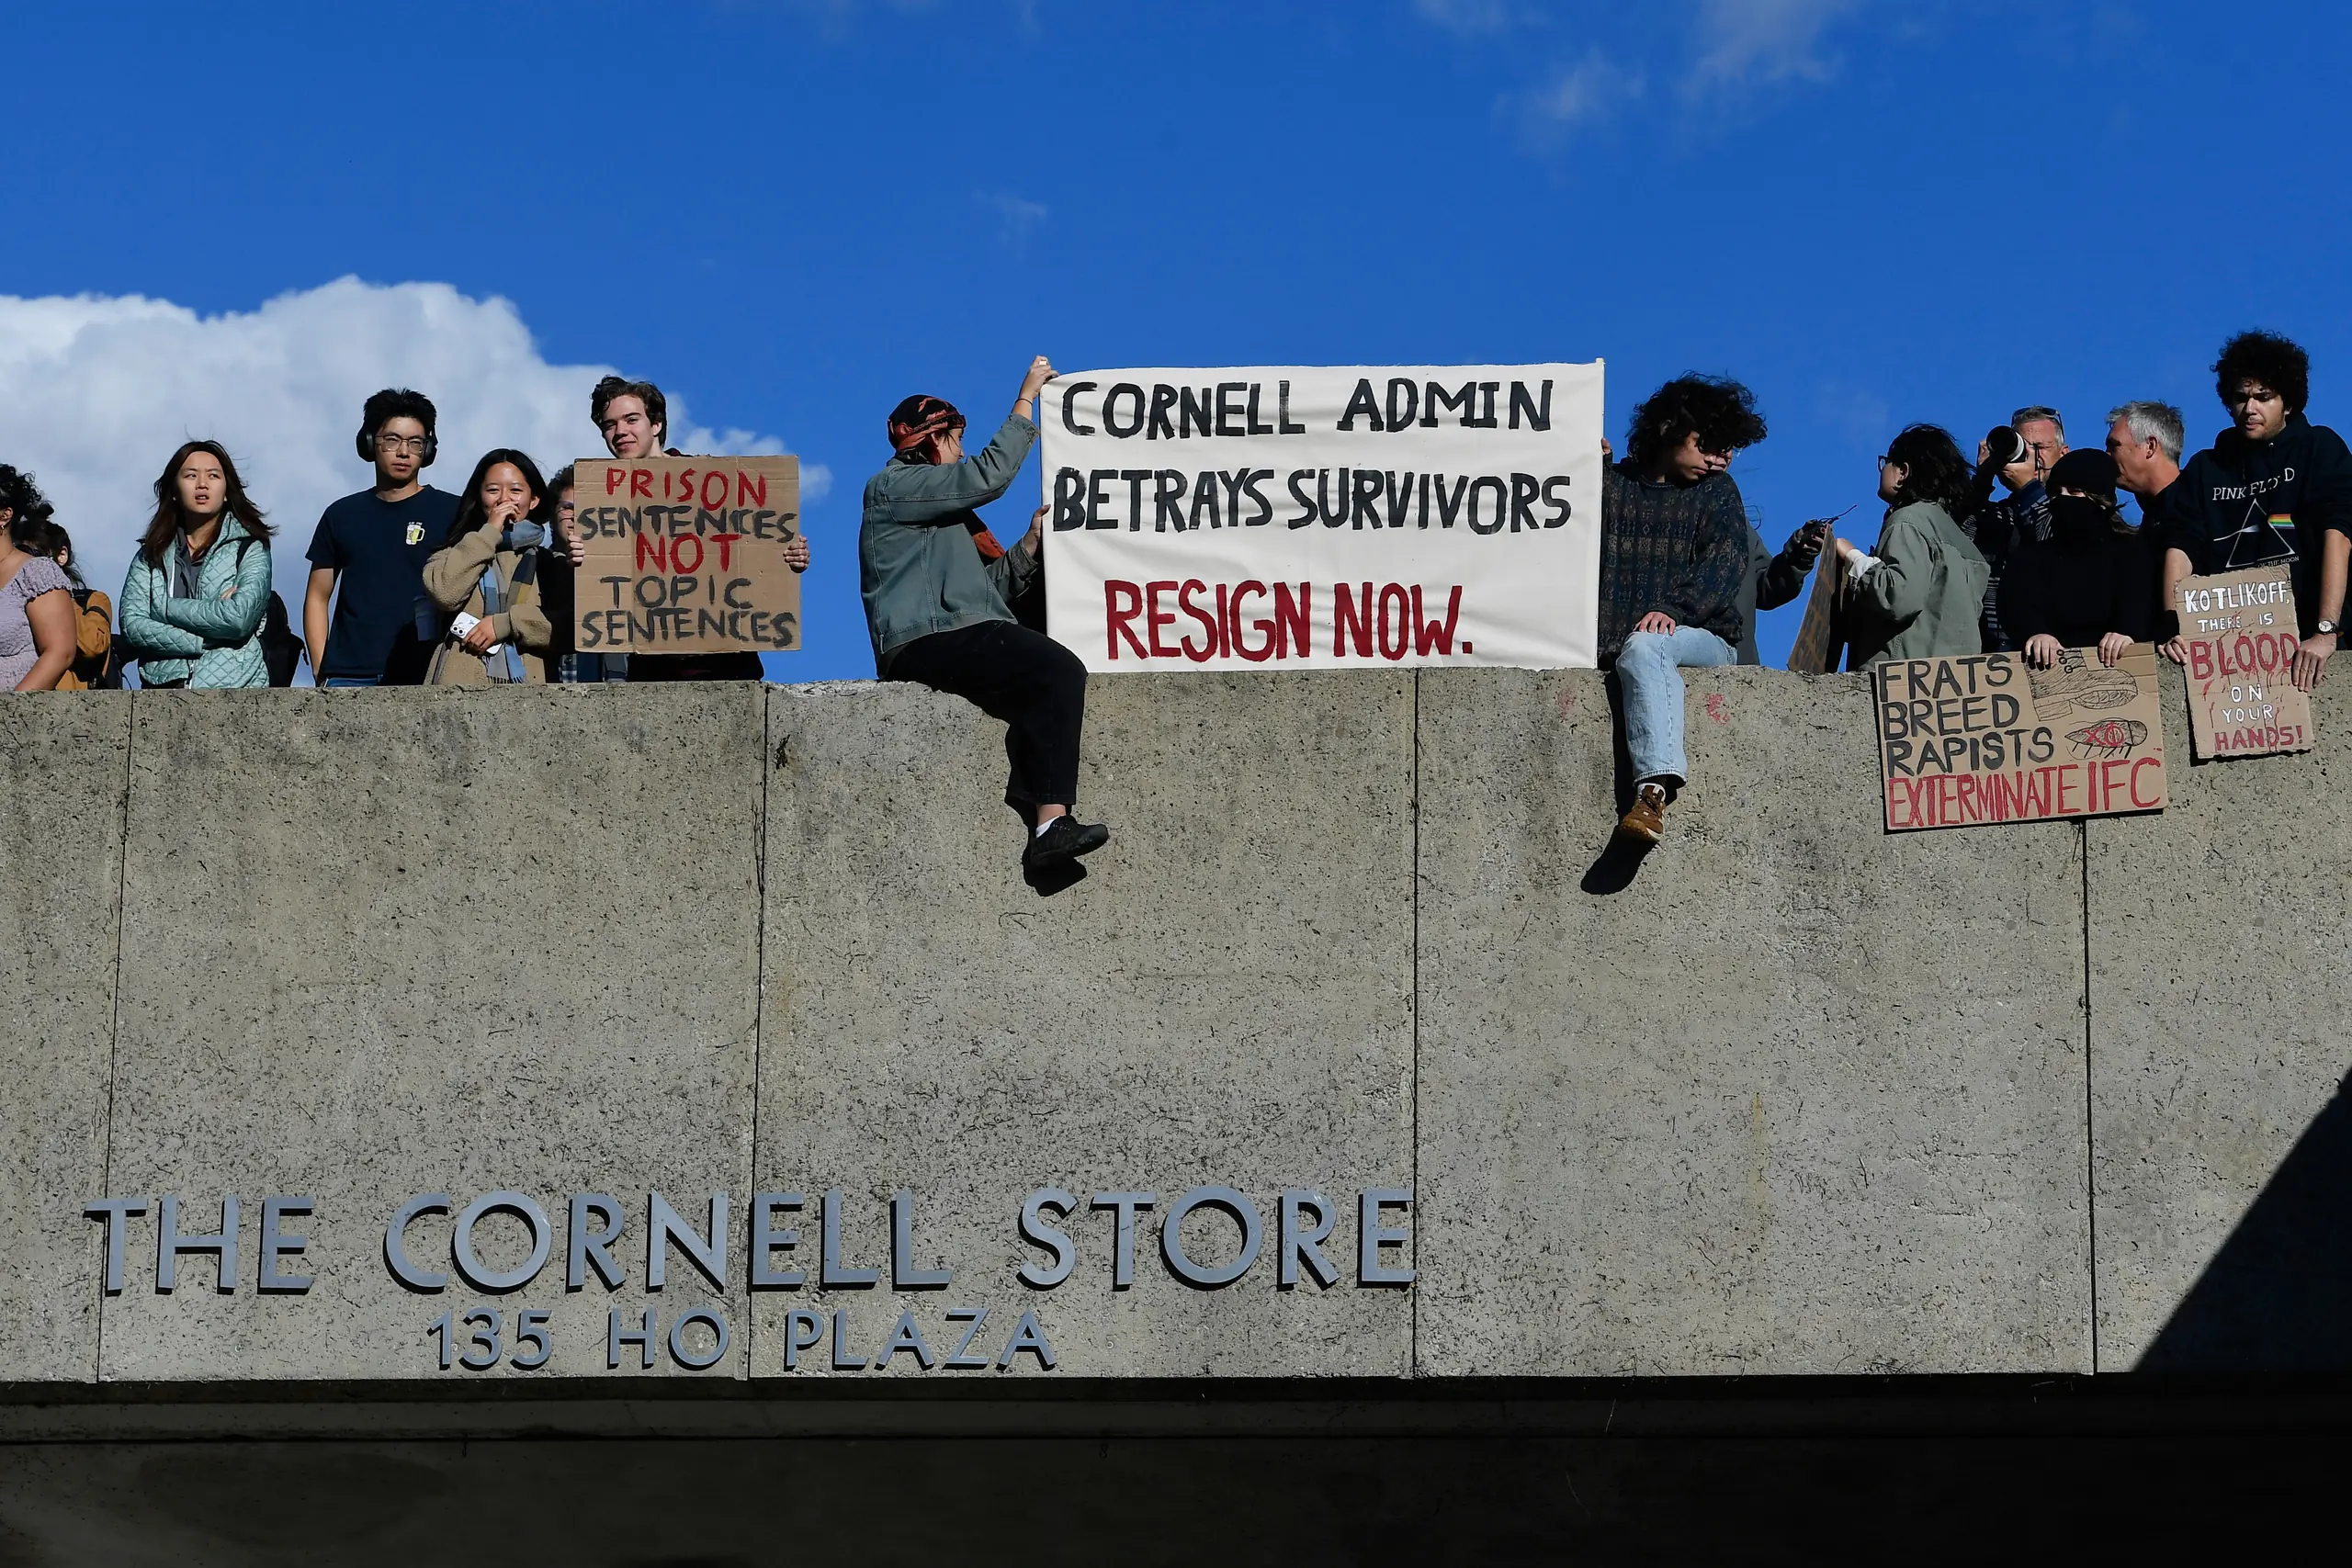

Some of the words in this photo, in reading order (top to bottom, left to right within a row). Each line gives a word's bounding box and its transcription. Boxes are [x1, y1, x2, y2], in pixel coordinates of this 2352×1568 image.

[1062, 379, 1306, 440] CORNELL
[1336, 378, 1554, 433] ADMIN
[606, 468, 767, 511] PRISON
[1053, 467, 1275, 534] BETRAYS
[1287, 468, 1571, 536] SURVIVORS
[2212, 487, 2247, 501] PINK
[2249, 468, 2295, 496] FLOD
[577, 505, 797, 543] SENTENCES
[636, 532, 742, 575] NOT
[600, 574, 753, 610] TOPIC
[2184, 581, 2290, 614] KOTLIKOFF,
[582, 607, 797, 649] SENTENCES
[1104, 579, 1311, 662] RESIGN
[1334, 581, 1473, 661] NOW.
[2197, 615, 2242, 633] THERE
[2258, 613, 2275, 626] IS
[1878, 653, 2013, 703] FRATS
[2189, 632, 2300, 681] BLOOD
[2222, 704, 2274, 724] YOUR
[2231, 684, 2264, 703] ON
[1883, 694, 2020, 740] BREED
[2214, 725, 2303, 751] HANDS!
[1885, 727, 2054, 778] RAPISTS
[1888, 764, 2081, 828] EXTERMINATE
[2087, 757, 2162, 813] IFC
[85, 1194, 314, 1292] THE
[382, 1190, 954, 1292] CORNELL
[1016, 1187, 1418, 1290] STORE
[426, 1305, 552, 1370] 135
[607, 1305, 730, 1369] HO
[785, 1307, 1059, 1370] PLAZA
